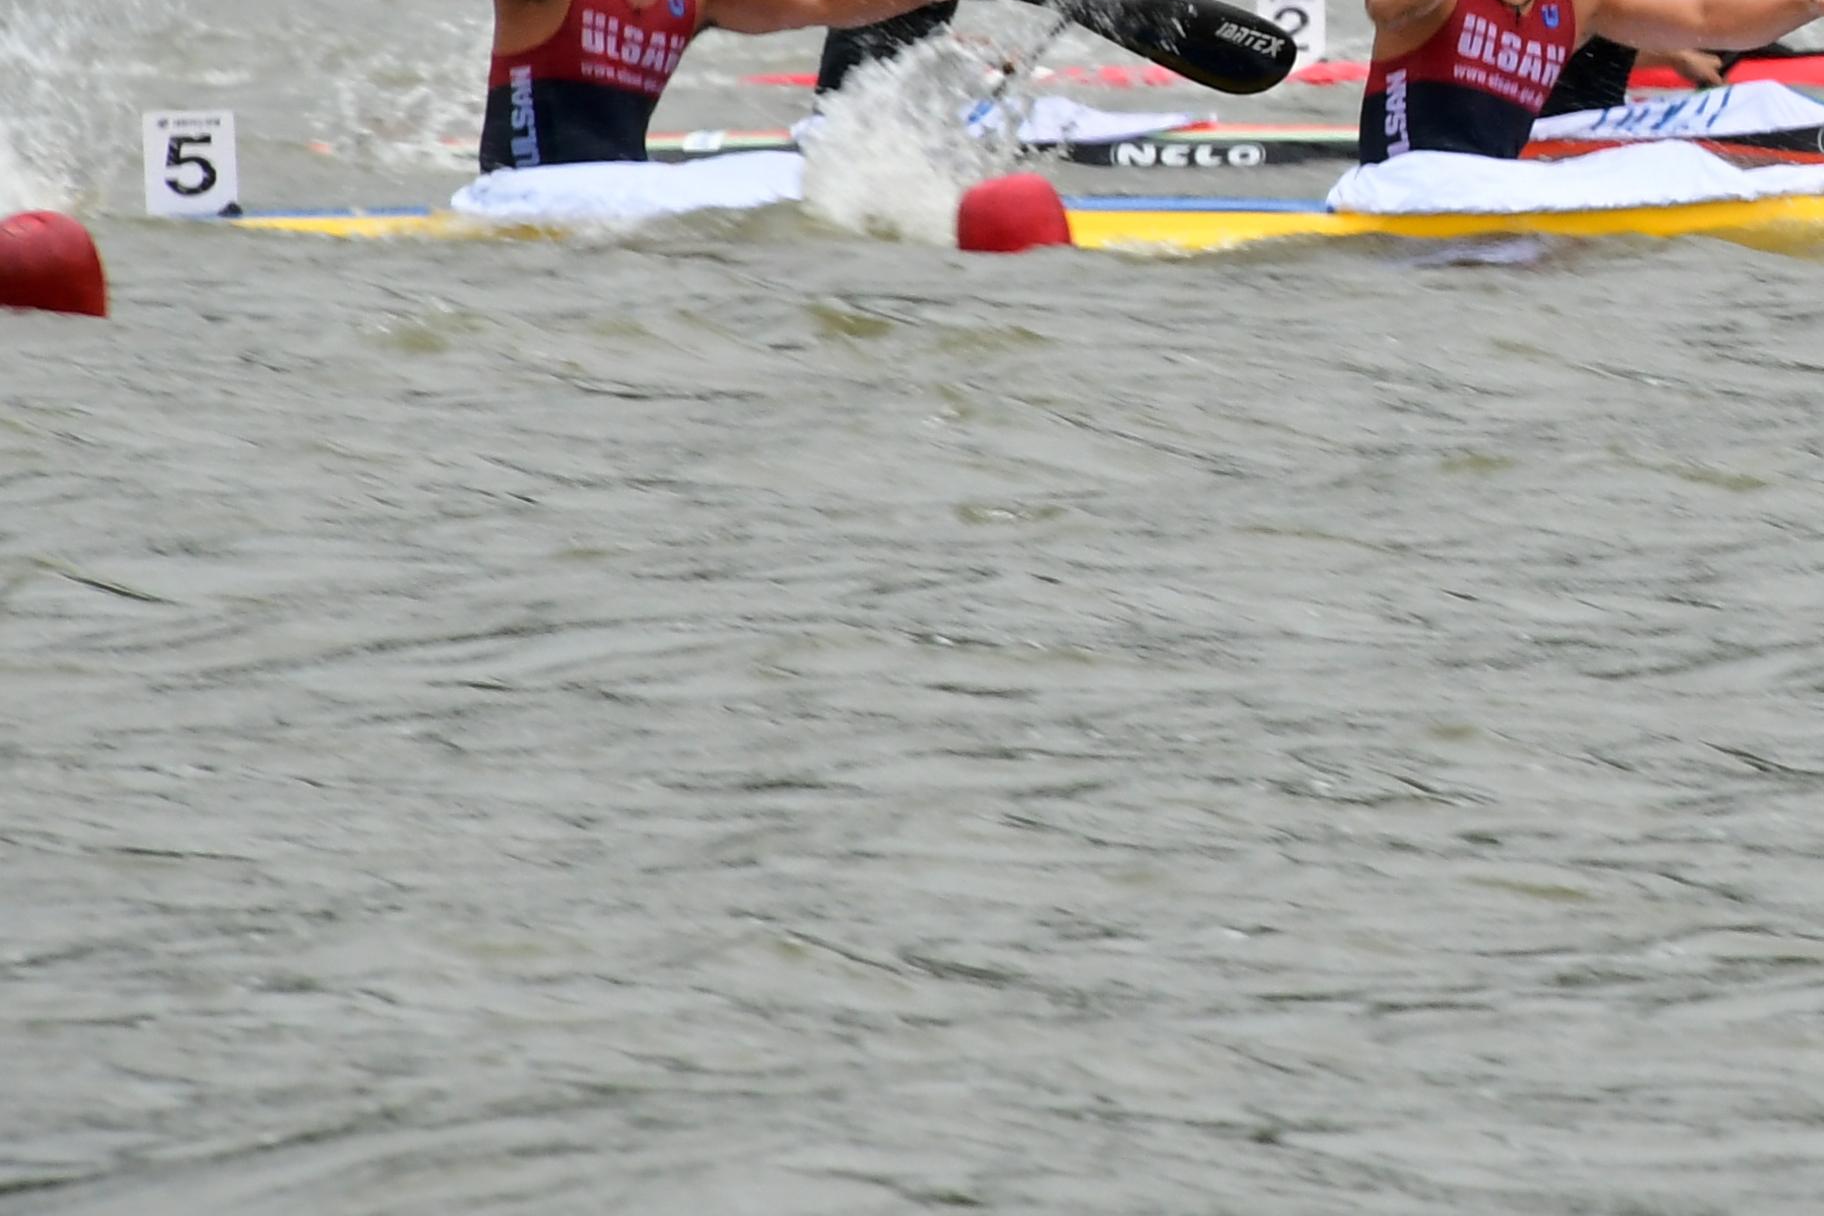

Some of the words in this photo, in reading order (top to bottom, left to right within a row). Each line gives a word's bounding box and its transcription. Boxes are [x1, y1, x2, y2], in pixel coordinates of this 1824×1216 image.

[1456, 12, 1566, 89] ULSAN
[509, 65, 541, 169] ULSAN
[165, 133, 217, 196] 5
[1116, 142, 1261, 167] NELO
